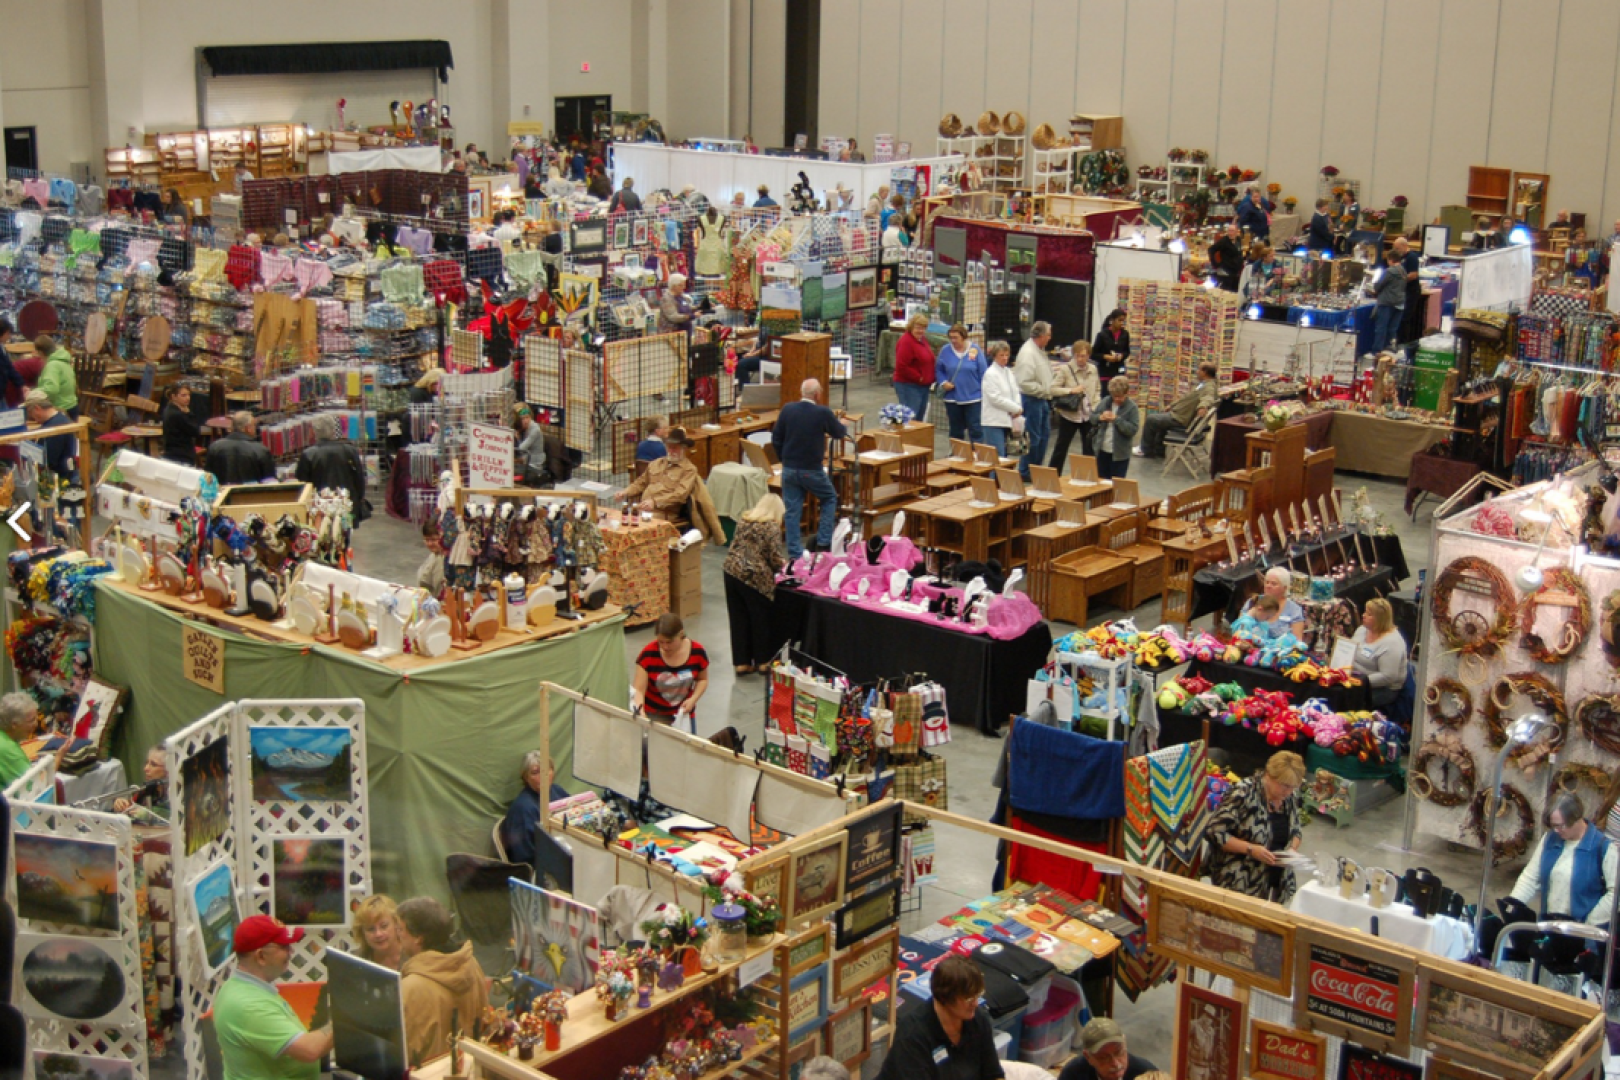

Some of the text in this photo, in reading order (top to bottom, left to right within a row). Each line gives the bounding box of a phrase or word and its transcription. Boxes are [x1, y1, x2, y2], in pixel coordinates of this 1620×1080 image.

[851, 848, 890, 871] Coffee
[1311, 968, 1396, 1013] Coca-Cola
[1264, 1034, 1311, 1060] Dad's
